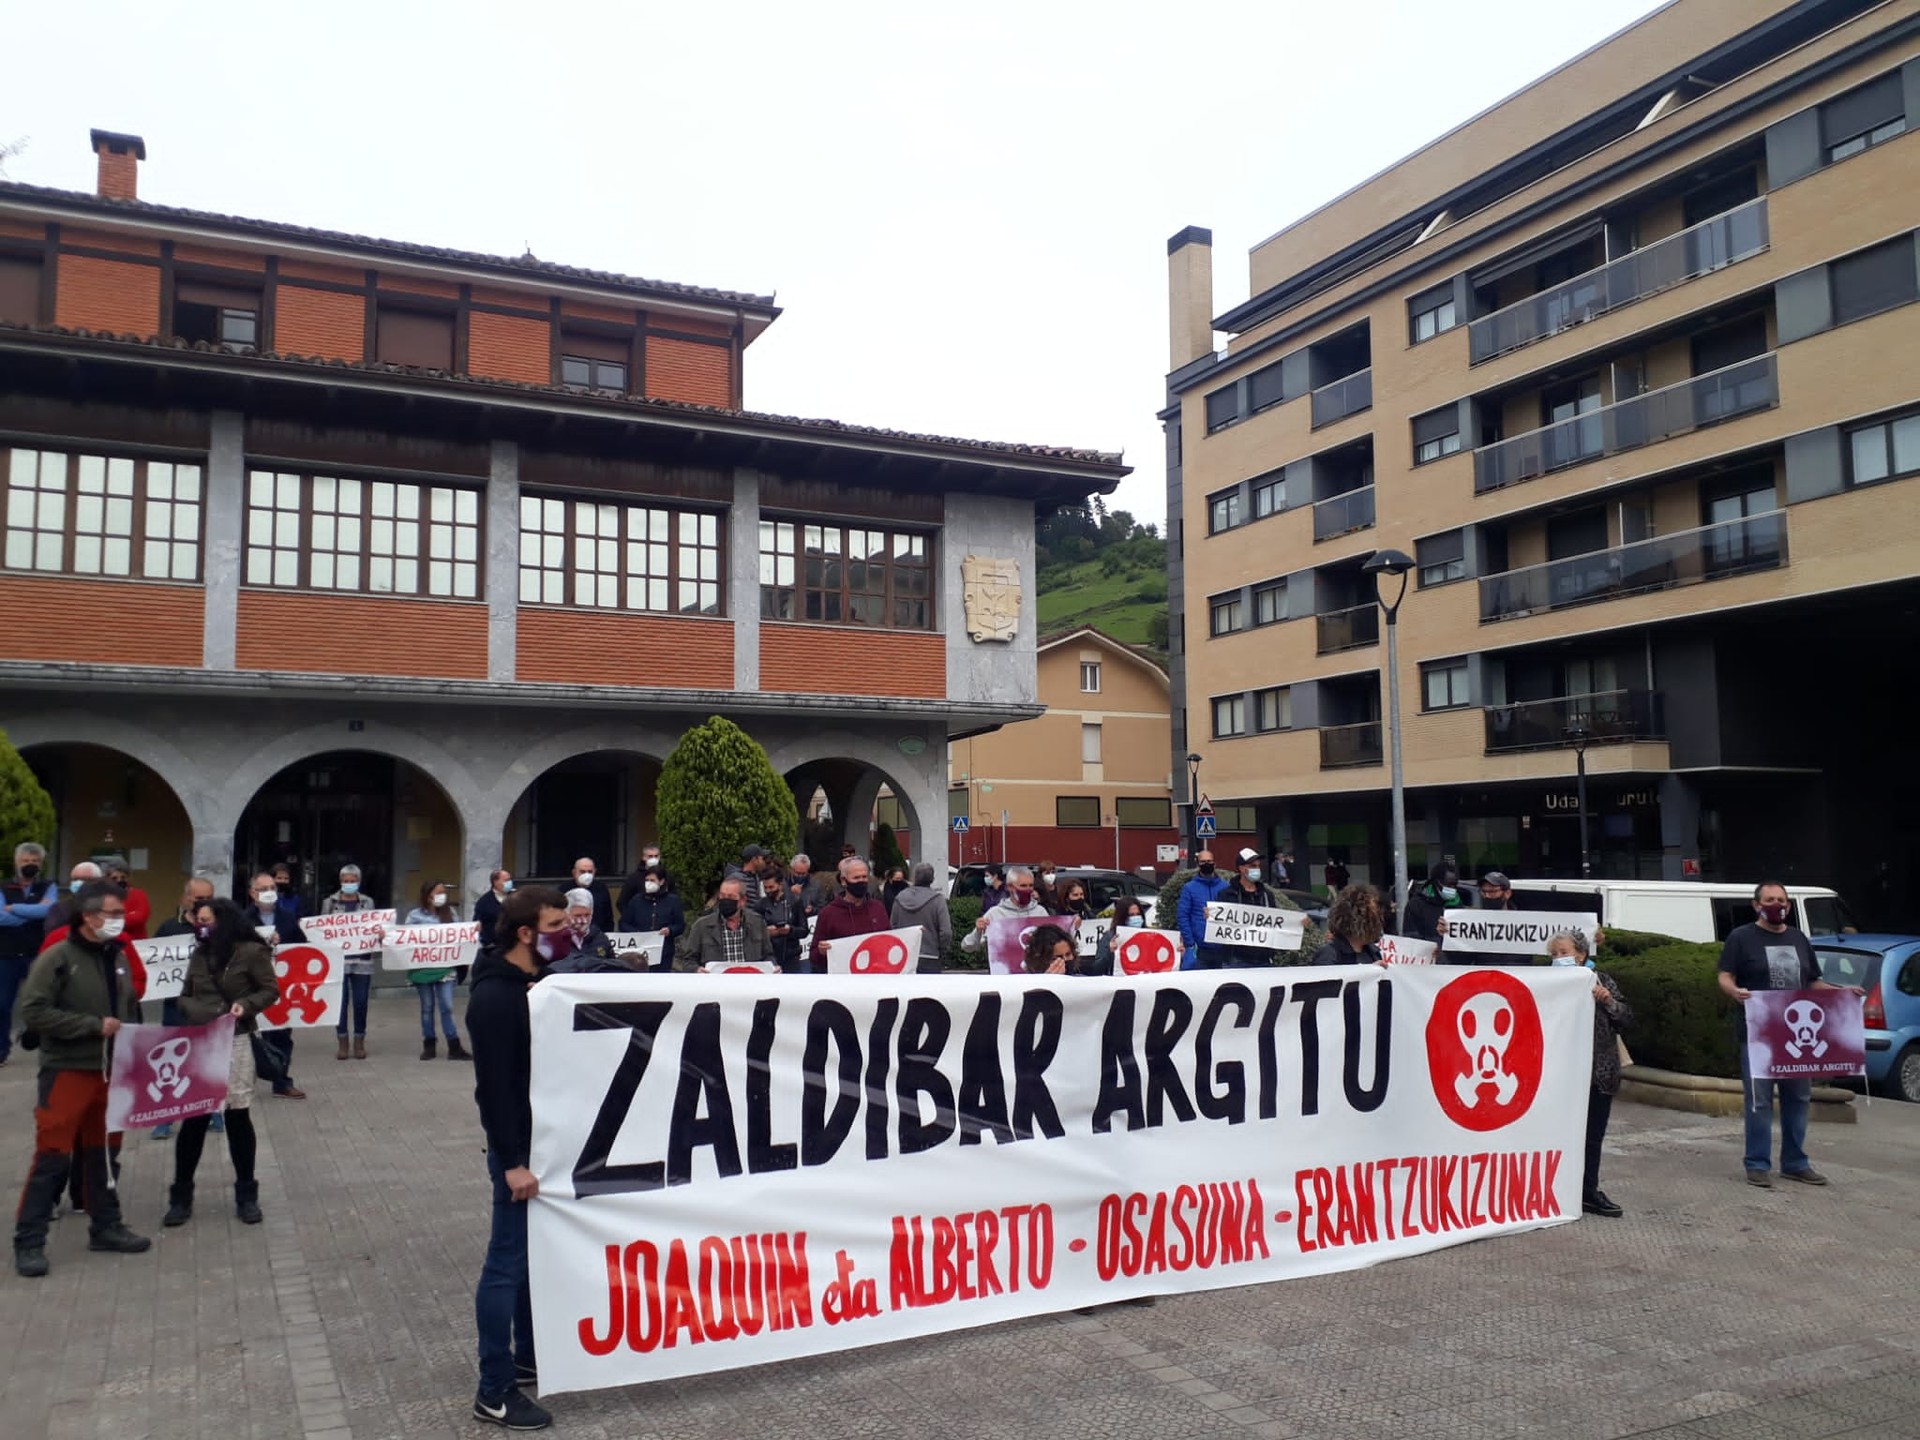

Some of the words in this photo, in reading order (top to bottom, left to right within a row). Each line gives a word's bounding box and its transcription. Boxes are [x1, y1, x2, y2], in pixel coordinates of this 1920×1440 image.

[1545, 794, 1580, 810] Uda
[1214, 906, 1285, 929] ZALDIBAR
[323, 923, 382, 940] BIZITZE
[395, 926, 479, 945] ZALDIBAR
[1215, 926, 1268, 944] ARGITU
[410, 947, 462, 964] ARGITU
[1822, 1062, 1856, 1072] ARGITU
[572, 988, 1066, 1200] ZALDIBAR
[1092, 980, 1393, 1134] ARGITU
[578, 1231, 813, 1356] JOAQUIN
[821, 1249, 884, 1326] eta
[889, 1203, 1055, 1311] ALBERTO
[1096, 1178, 1270, 1282] OSASUNA
[1294, 1150, 1563, 1253] ERANTZUKIZUNAK
